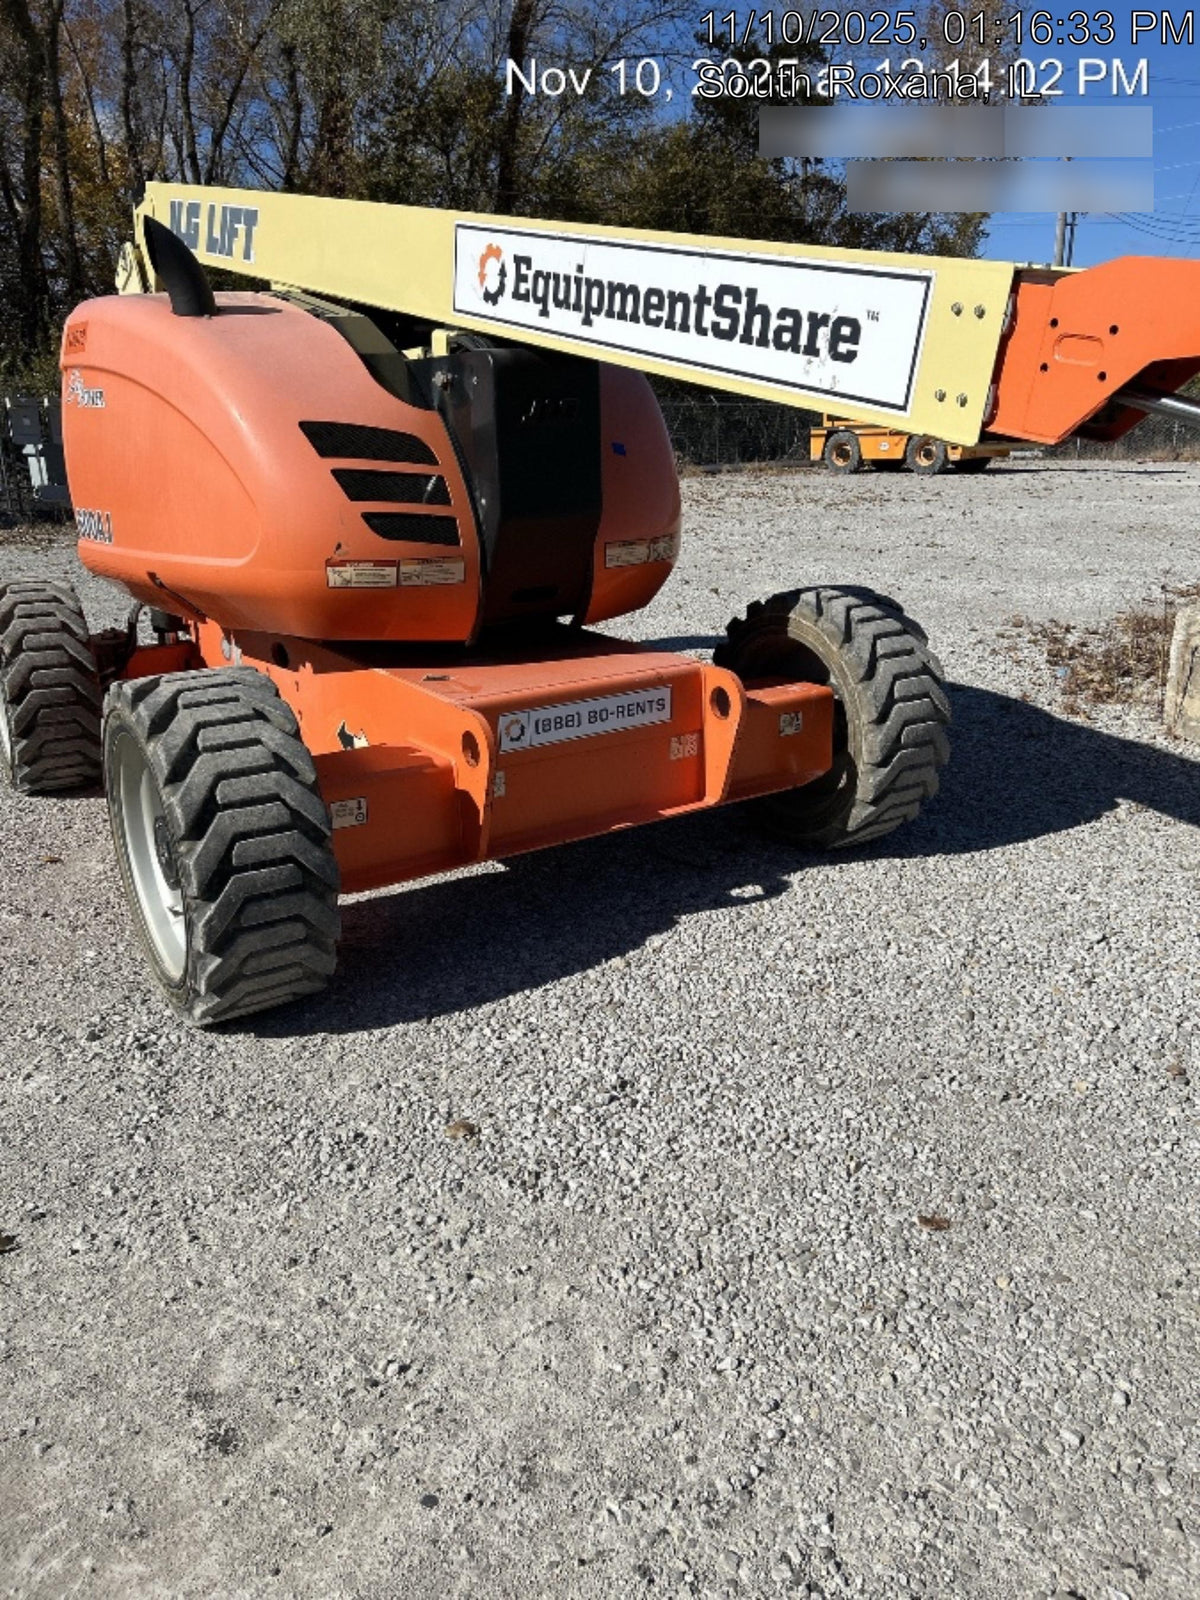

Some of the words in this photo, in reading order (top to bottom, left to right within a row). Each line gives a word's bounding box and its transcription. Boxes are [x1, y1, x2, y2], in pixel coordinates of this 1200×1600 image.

[206, 203, 259, 263] LIFT
[511, 253, 863, 364] EquipmentShare
[534, 711, 582, 736] (888)
